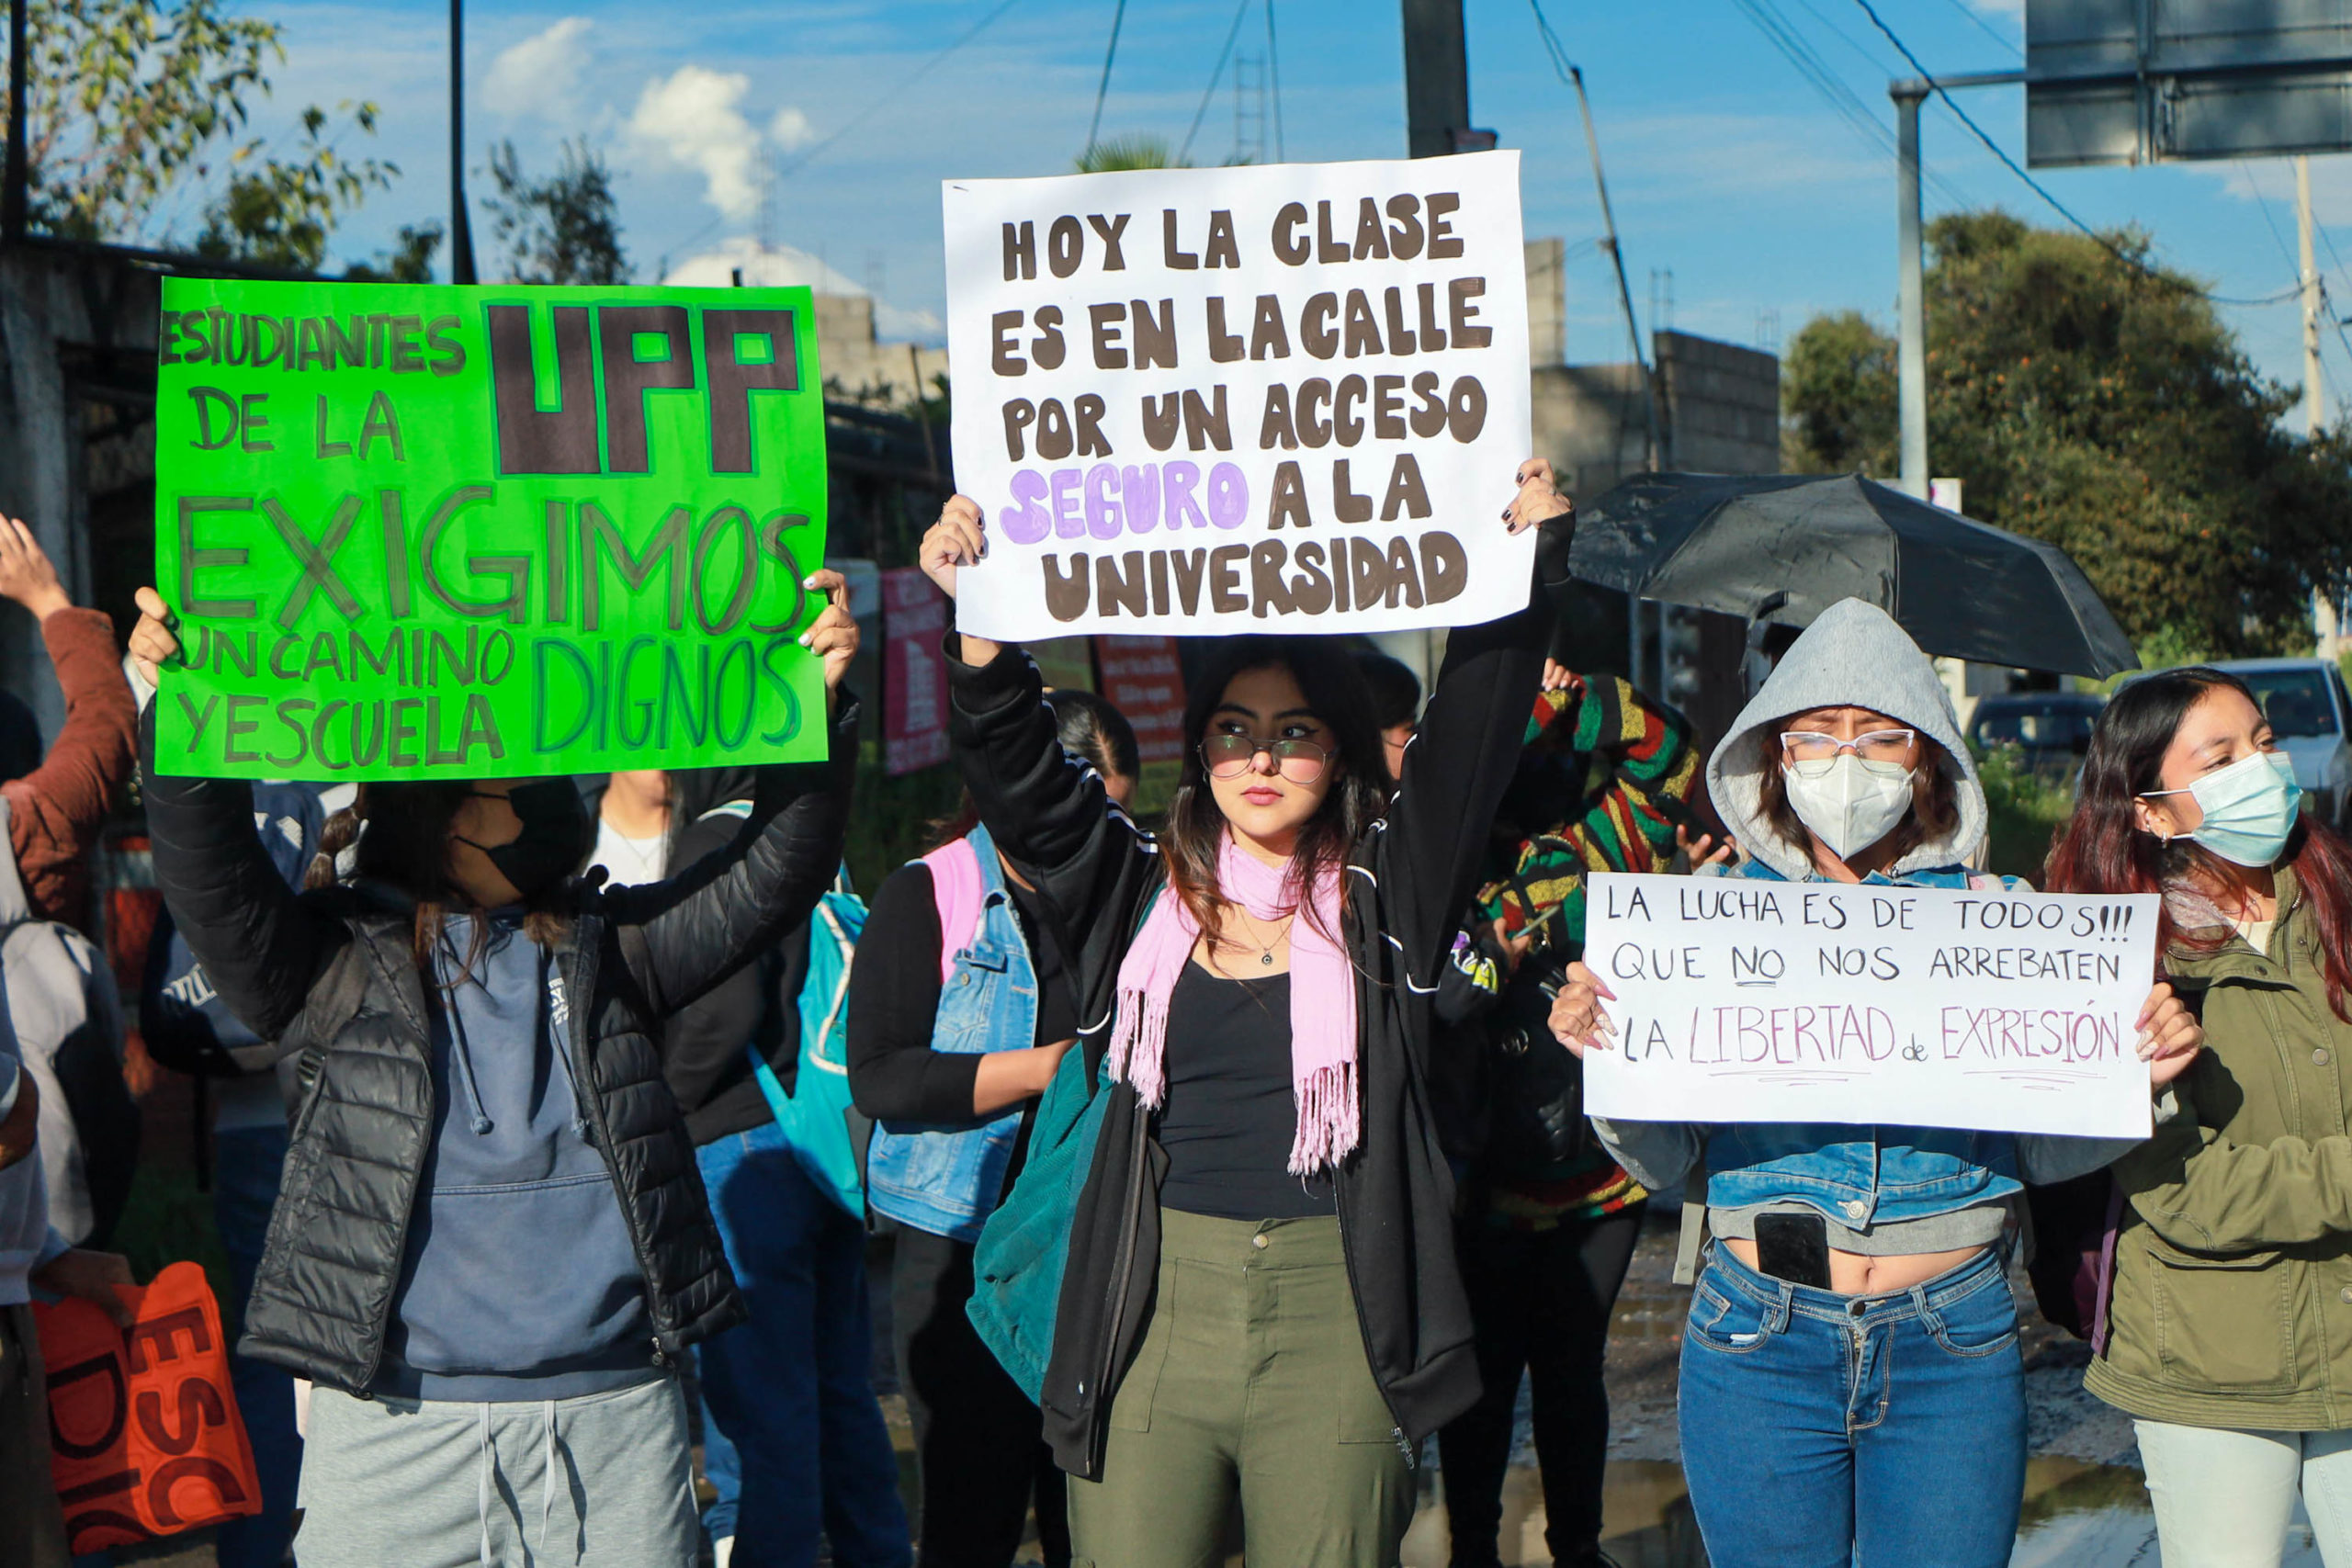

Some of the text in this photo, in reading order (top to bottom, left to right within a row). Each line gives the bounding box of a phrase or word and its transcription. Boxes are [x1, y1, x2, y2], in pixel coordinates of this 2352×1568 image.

[1002, 192, 1464, 282] HOY LA CLASE
[161, 305, 466, 378] ESTUDIANTES
[991, 276, 1493, 377] ES EN LA CALLE
[187, 386, 405, 461] DE LA
[482, 300, 802, 477] UPP
[1002, 371, 1487, 462] POR UN ACCESO
[1001, 453, 1432, 545] SEGURO A LA
[177, 484, 811, 636] EXIGIMOS
[1042, 531, 1468, 622] UNIVERSIDAD
[269, 628, 514, 687] CAMINO
[532, 636, 803, 752] DIGNOS
[1609, 886, 2133, 943] LA LUCHA ES DE TODOS!!!
[1612, 942, 2119, 985] QUE NO NOS ARREBATEN
[1625, 999, 2120, 1064] LA LIBERTAD de EXPRESIÓN
